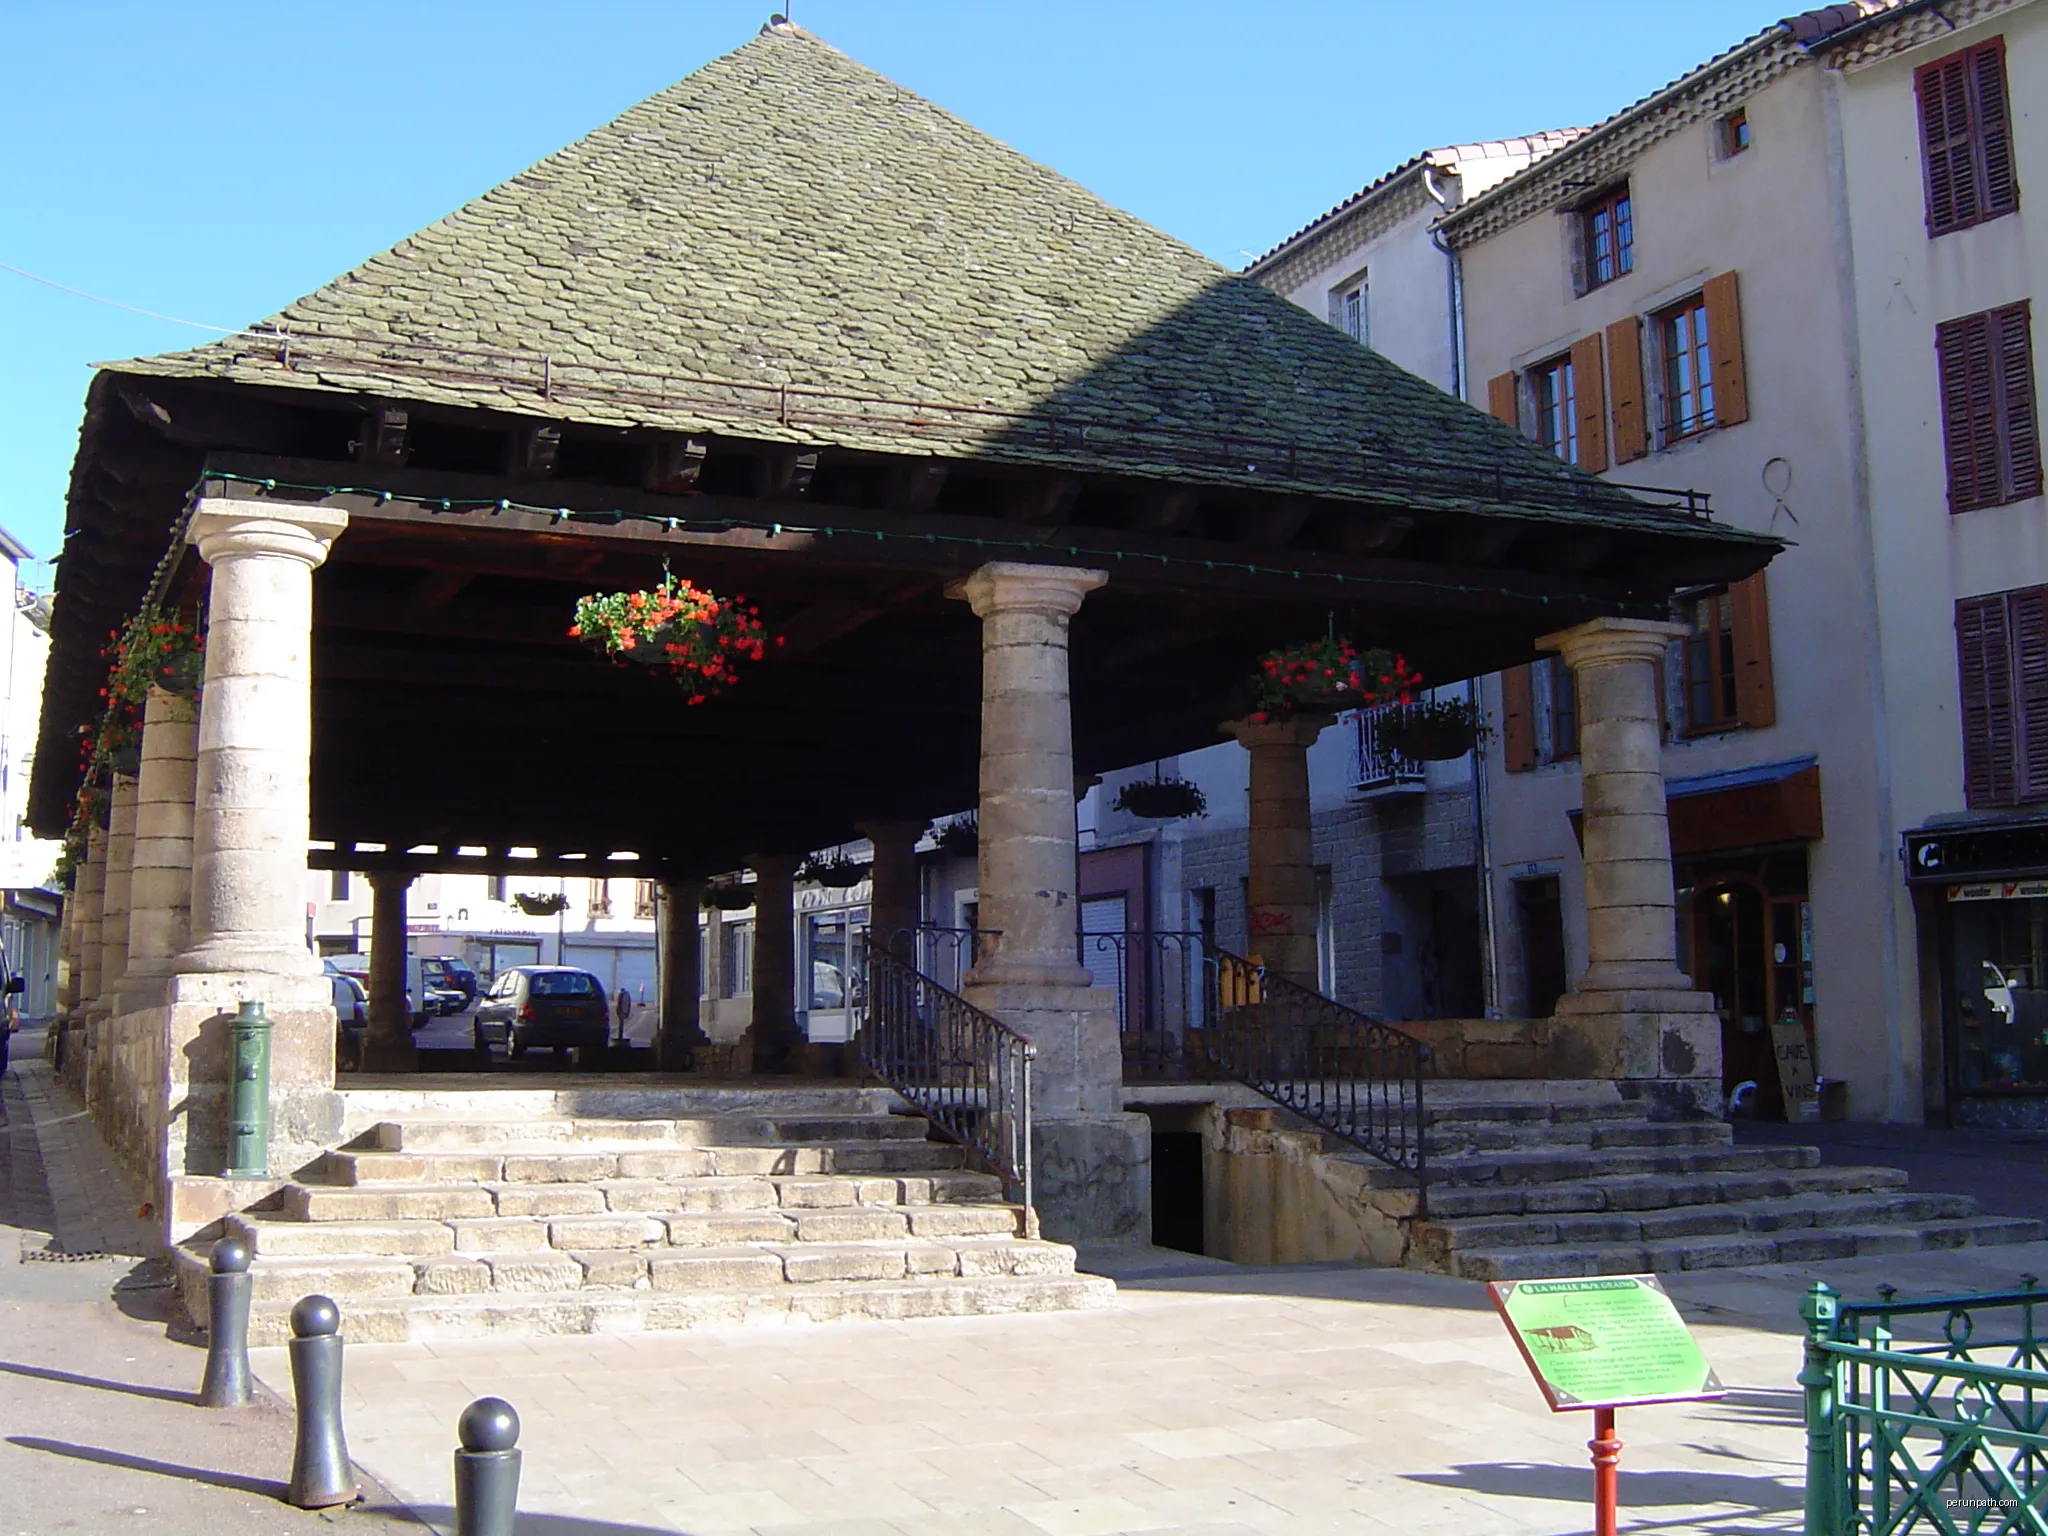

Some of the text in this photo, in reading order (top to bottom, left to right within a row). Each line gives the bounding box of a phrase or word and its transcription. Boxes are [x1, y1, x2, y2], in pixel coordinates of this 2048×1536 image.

[1777, 1044, 1809, 1060] CAVE
[1534, 1285, 1547, 1293] LA
[1550, 1283, 1578, 1293] HALLE
